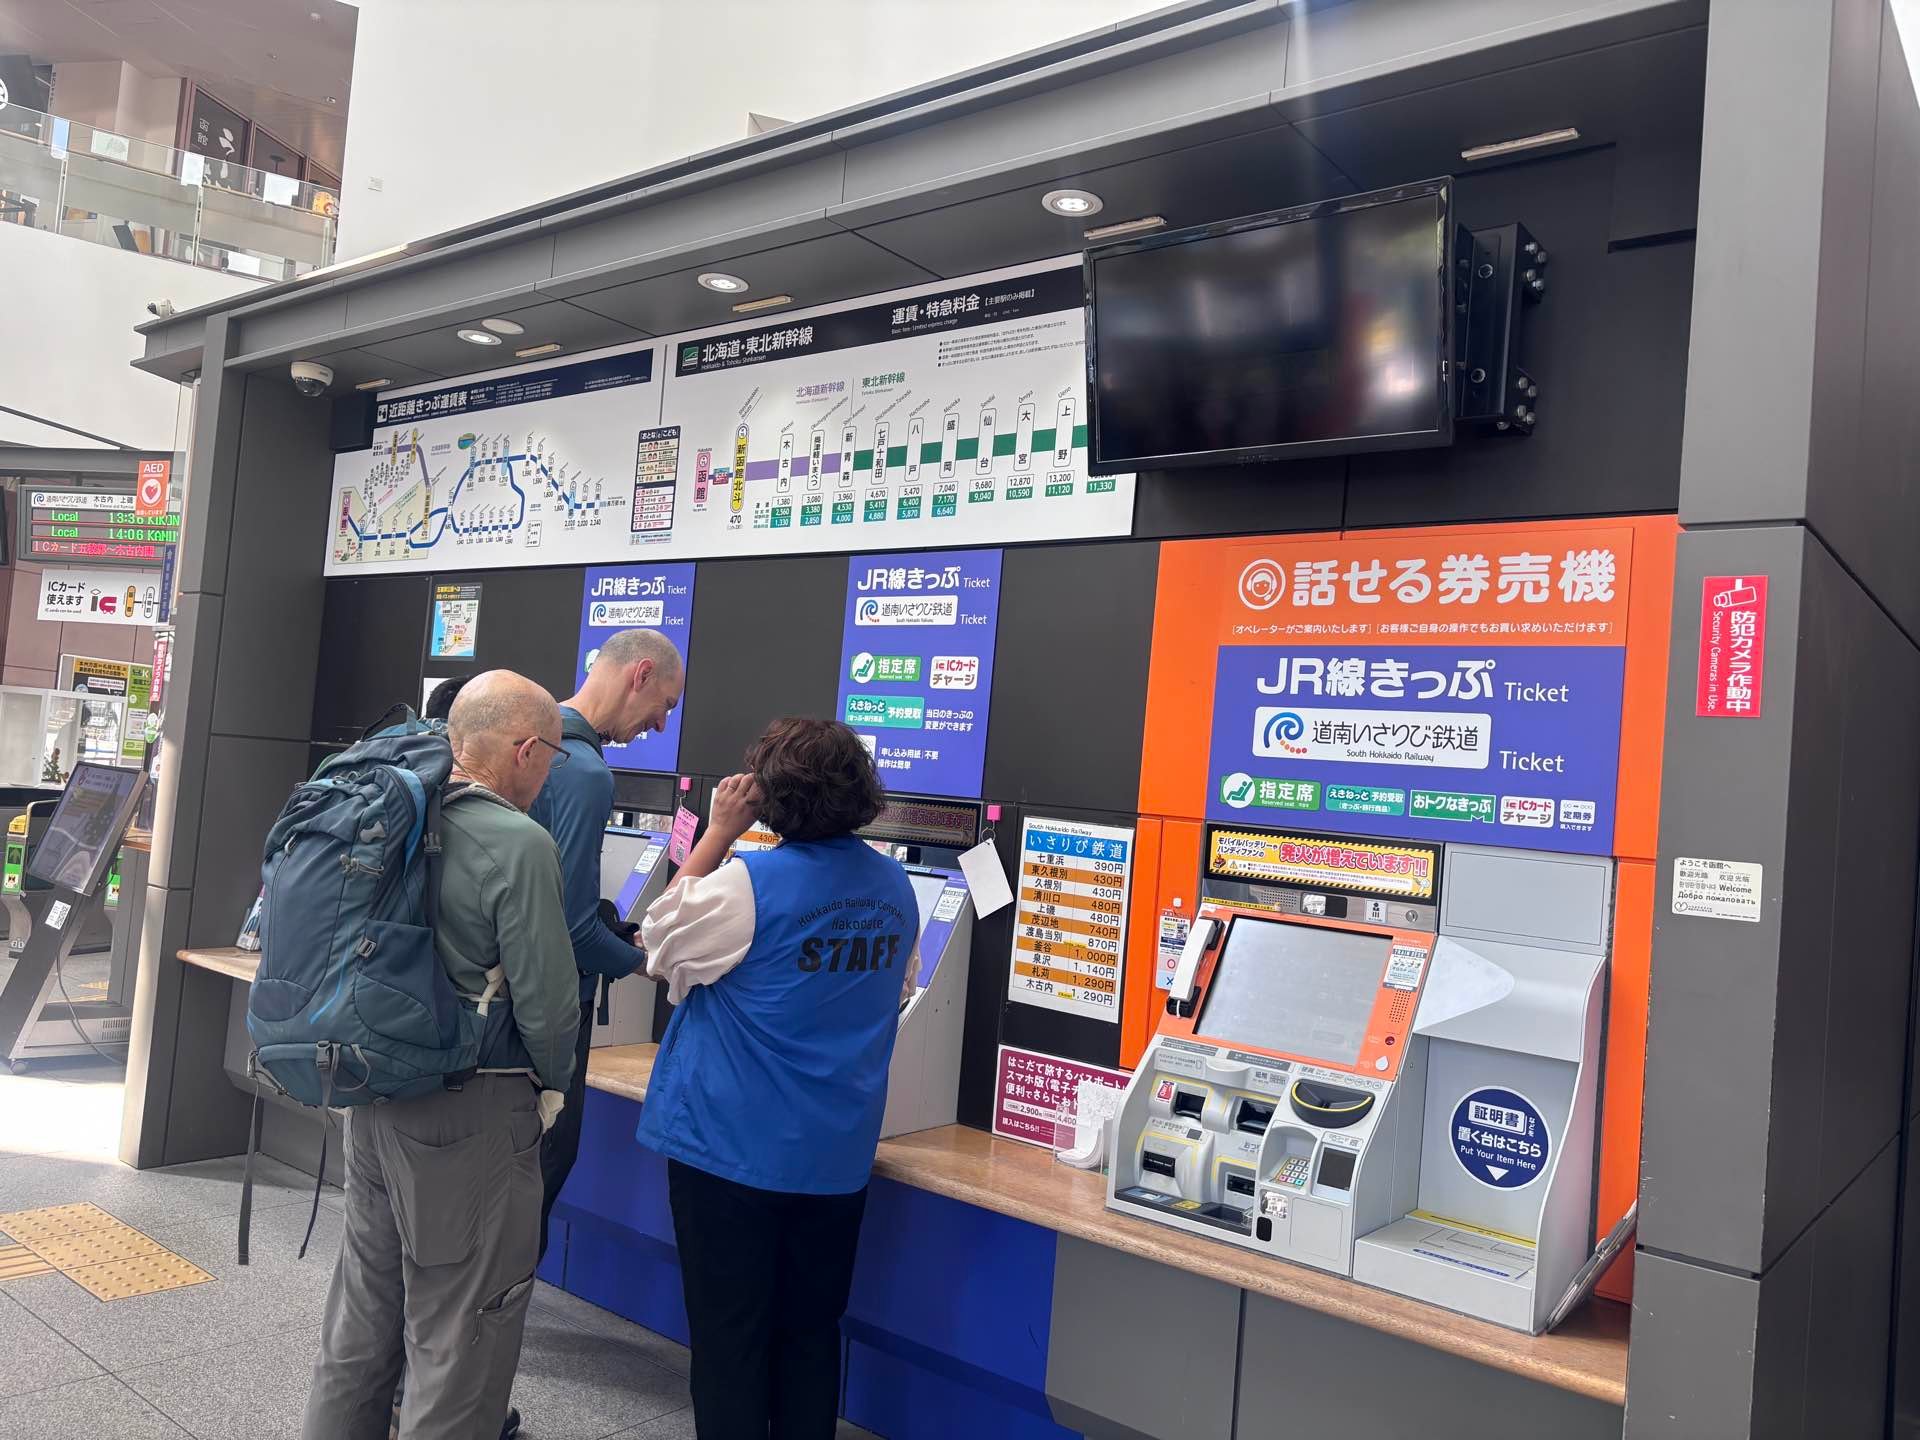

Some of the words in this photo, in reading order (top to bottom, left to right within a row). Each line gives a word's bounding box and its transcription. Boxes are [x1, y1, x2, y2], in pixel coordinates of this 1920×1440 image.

[892, 293, 980, 325] 運賃・特急料金
[702, 325, 813, 362] 北海道・東北新幹線
[862, 371, 906, 389] 東北新幹線
[796, 380, 845, 398] 北海道新幹線
[388, 391, 468, 419] 近距離きっぷ運賃表
[1017, 410, 1031, 465] 大宮
[1058, 404, 1071, 461] 上野
[908, 424, 920, 476] 八戸
[980, 415, 993, 469] 仙台
[842, 432, 854, 481] 新青森
[874, 429, 887, 479] 七戸十和田
[143, 463, 164, 473] AED
[780, 440, 791, 488] 木古内
[974, 480, 993, 490] 9,680
[1008, 475, 1031, 487] 12,870
[1048, 472, 1072, 484] 13,200
[1088, 480, 1114, 492] 11,330
[870, 489, 886, 499] 4,670
[903, 487, 920, 497] 5,470
[1008, 487, 1030, 499] 10,590
[1047, 485, 1071, 496] 11,120
[94, 496, 114, 504] 木古内
[868, 500, 885, 510] 5,410
[52, 509, 79, 522] Local
[729, 515, 742, 524] 470
[52, 525, 79, 538] Local
[109, 528, 144, 541] 14:06
[591, 575, 667, 597] JR線きっぷ
[667, 585, 687, 595] Ticket
[857, 565, 962, 591] JR線きっぷ
[963, 577, 991, 589] Ticket
[1292, 548, 1617, 607] 話せる券売機
[48, 581, 86, 593] ICカード
[46, 594, 84, 606] 使えます
[664, 616, 685, 626] Ticket
[881, 602, 953, 617] 道南いさりび鉄道
[959, 613, 988, 626] Ticket
[1709, 610, 1723, 645] Security
[877, 658, 917, 675] 指定席
[946, 659, 977, 672] ICカード
[1708, 646, 1721, 682] Cameras
[1725, 610, 1757, 713] 防犯カメラ作動中
[932, 673, 976, 686] チャージ
[1256, 656, 1497, 701] JR線きっぷ
[1504, 681, 1570, 704] Ticket
[1708, 683, 1719, 692] in
[849, 699, 886, 713] えきねっと
[887, 707, 923, 720] 予約受取
[1707, 694, 1719, 712] Use.
[925, 708, 975, 721] 当日のきっぷの
[924, 720, 974, 732] 変更ができます
[1311, 720, 1479, 752] 道南いさりび鉄道
[1499, 749, 1565, 774] Ticket
[877, 758, 912, 770] 操作は簡単
[1346, 749, 1367, 759] South
[1369, 750, 1403, 760] Hokkaido
[1404, 751, 1435, 763] Railway
[1259, 780, 1315, 803] 指定席
[1328, 788, 1370, 801] えきねっと
[1371, 791, 1405, 803] 予約受取
[1413, 794, 1492, 814] おトクなきっぷ
[1518, 799, 1553, 811] ICカード
[1502, 811, 1552, 825] チャージ
[1562, 810, 1593, 822] 定期券
[1028, 822, 1044, 831] South
[1044, 824, 1070, 835] Hokkaido
[1070, 827, 1093, 837] Railway
[1028, 833, 1124, 860] いさりび鉄道
[1216, 845, 1265, 857] ハンディファンの
[1217, 837, 1279, 850] モバイルバッテリーや
[1036, 853, 1065, 866] 七重浜
[1094, 860, 1124, 875] 390円
[1279, 842, 1429, 877] 発火が増えています!!
[1679, 859, 1732, 870] ようこそ函館へ
[1031, 863, 1068, 880] 東久根別
[1093, 873, 1123, 888] 430円
[1034, 878, 1063, 892] 久根別
[1092, 887, 1122, 901] 430円
[1719, 883, 1753, 894] Welcome
[845, 897, 876, 911] Railway
[1032, 890, 1062, 903] 清川口
[1091, 899, 1121, 914] 480円
[1677, 890, 1704, 901] Добро
[1705, 894, 1757, 906] пожаловать
[1036, 903, 1056, 916] 上磯
[1090, 912, 1120, 927] 480円
[831, 917, 885, 931] Hakodate
[1031, 914, 1060, 929] 茂辺地
[1089, 924, 1119, 939] 740円
[1025, 926, 1063, 943] 渡島当別
[1087, 938, 1118, 952] 870円
[797, 934, 901, 973] STAFF
[1032, 953, 1051, 966] 泉沢
[1025, 979, 1054, 994] 木古内
[1007, 1056, 1126, 1091] はこだて旅するパスポート
[1474, 1104, 1520, 1128] 証明書
[1457, 1125, 1543, 1158] 置く台はこちら
[1460, 1145, 1474, 1156] Put
[1475, 1148, 1495, 1161] Your
[1496, 1153, 1515, 1166] Item
[1516, 1158, 1537, 1171] Here
